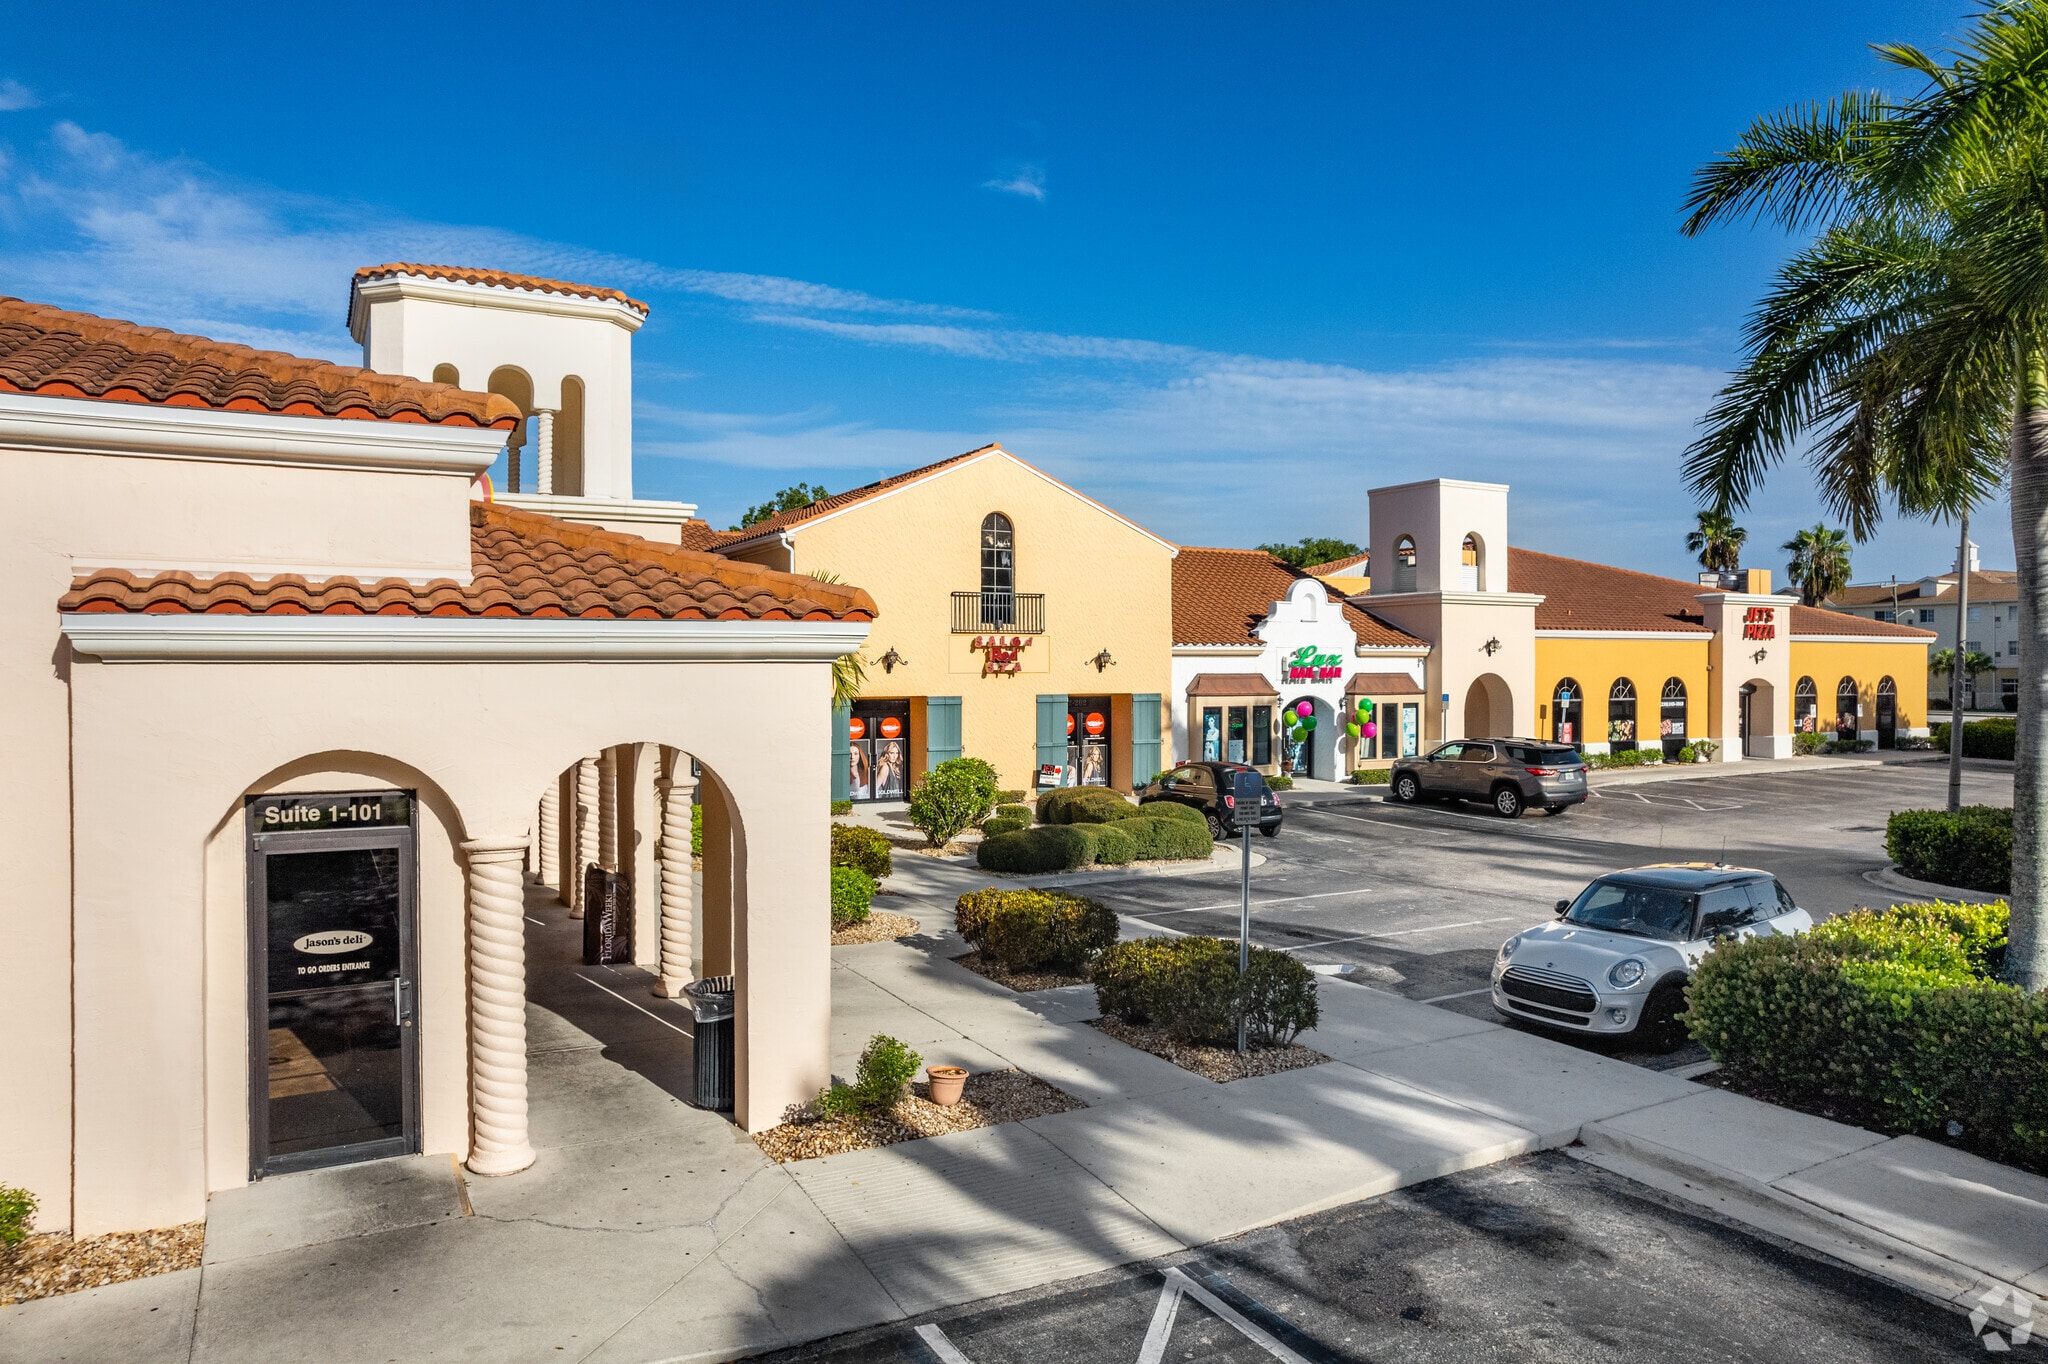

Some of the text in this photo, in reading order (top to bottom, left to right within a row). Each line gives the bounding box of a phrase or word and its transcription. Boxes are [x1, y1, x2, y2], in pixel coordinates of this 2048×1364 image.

[1746, 624, 1775, 639] PIZZA
[990, 647, 1018, 662] Red
[1290, 645, 1343, 667] Lux
[1289, 667, 1342, 679] NAIL BAR
[265, 803, 381, 824] Suite 1-101
[601, 891, 614, 922] WEEKL
[304, 934, 363, 950] Jason's deli
[297, 961, 371, 975] TO GO ORDERS ENTRANCE
